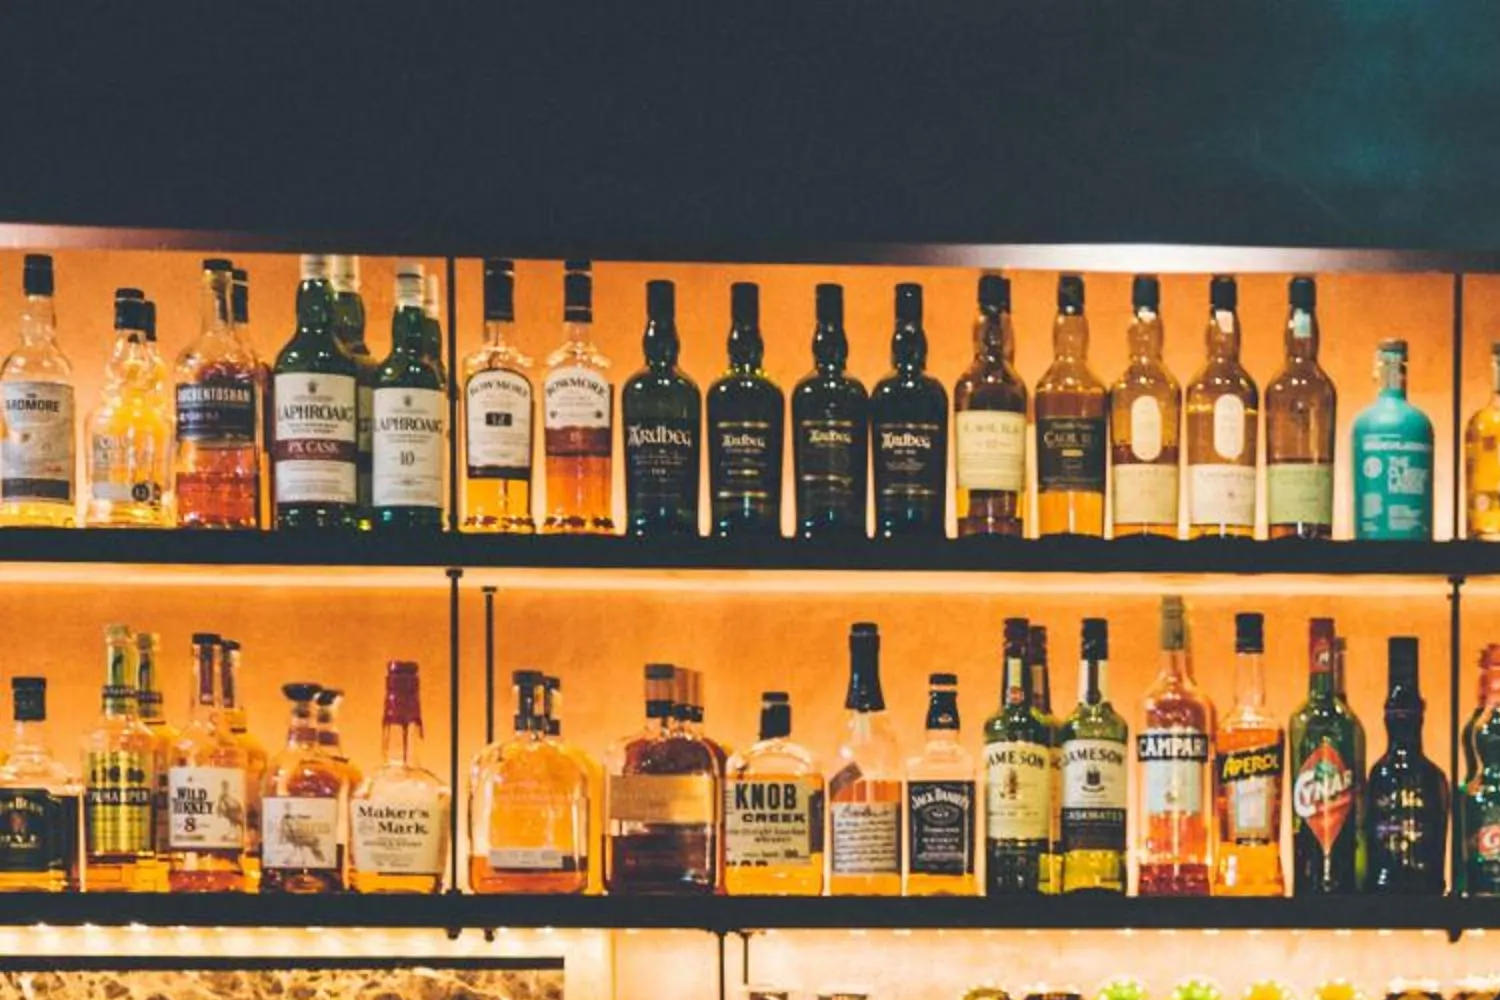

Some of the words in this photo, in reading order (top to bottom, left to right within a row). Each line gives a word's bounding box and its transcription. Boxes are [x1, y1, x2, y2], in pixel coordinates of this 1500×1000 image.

[277, 404, 354, 422] LAPHROAIG
[376, 418, 442, 433] LAPHROAIG
[399, 451, 415, 466] 10
[988, 750, 1045, 770] AMESON
[1222, 752, 1280, 780] APEROL
[176, 787, 207, 801] WILD
[735, 782, 797, 810] KNOB
[356, 803, 431, 820] Maker's
[741, 813, 806, 823] CREEK
[184, 816, 196, 833] 8
